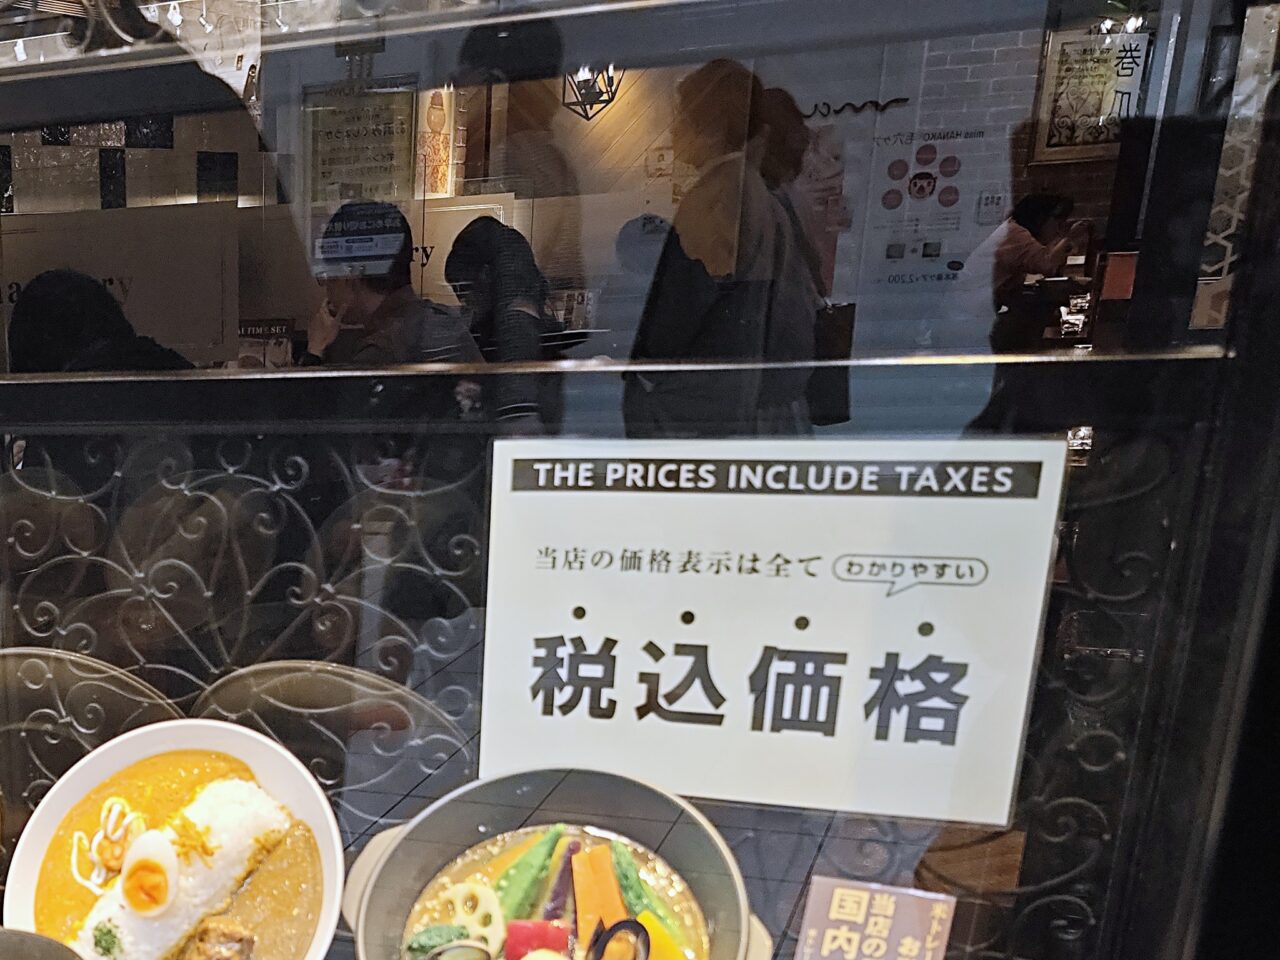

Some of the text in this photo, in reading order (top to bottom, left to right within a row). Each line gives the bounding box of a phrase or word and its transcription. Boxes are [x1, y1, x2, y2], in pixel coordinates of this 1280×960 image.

[534, 462, 1014, 493] THE PRICES INCLUDE TAXES
[535, 547, 825, 580] 当店の価格表示は全て
[845, 560, 976, 579] わかりやすい
[530, 634, 971, 747] 税込価格
